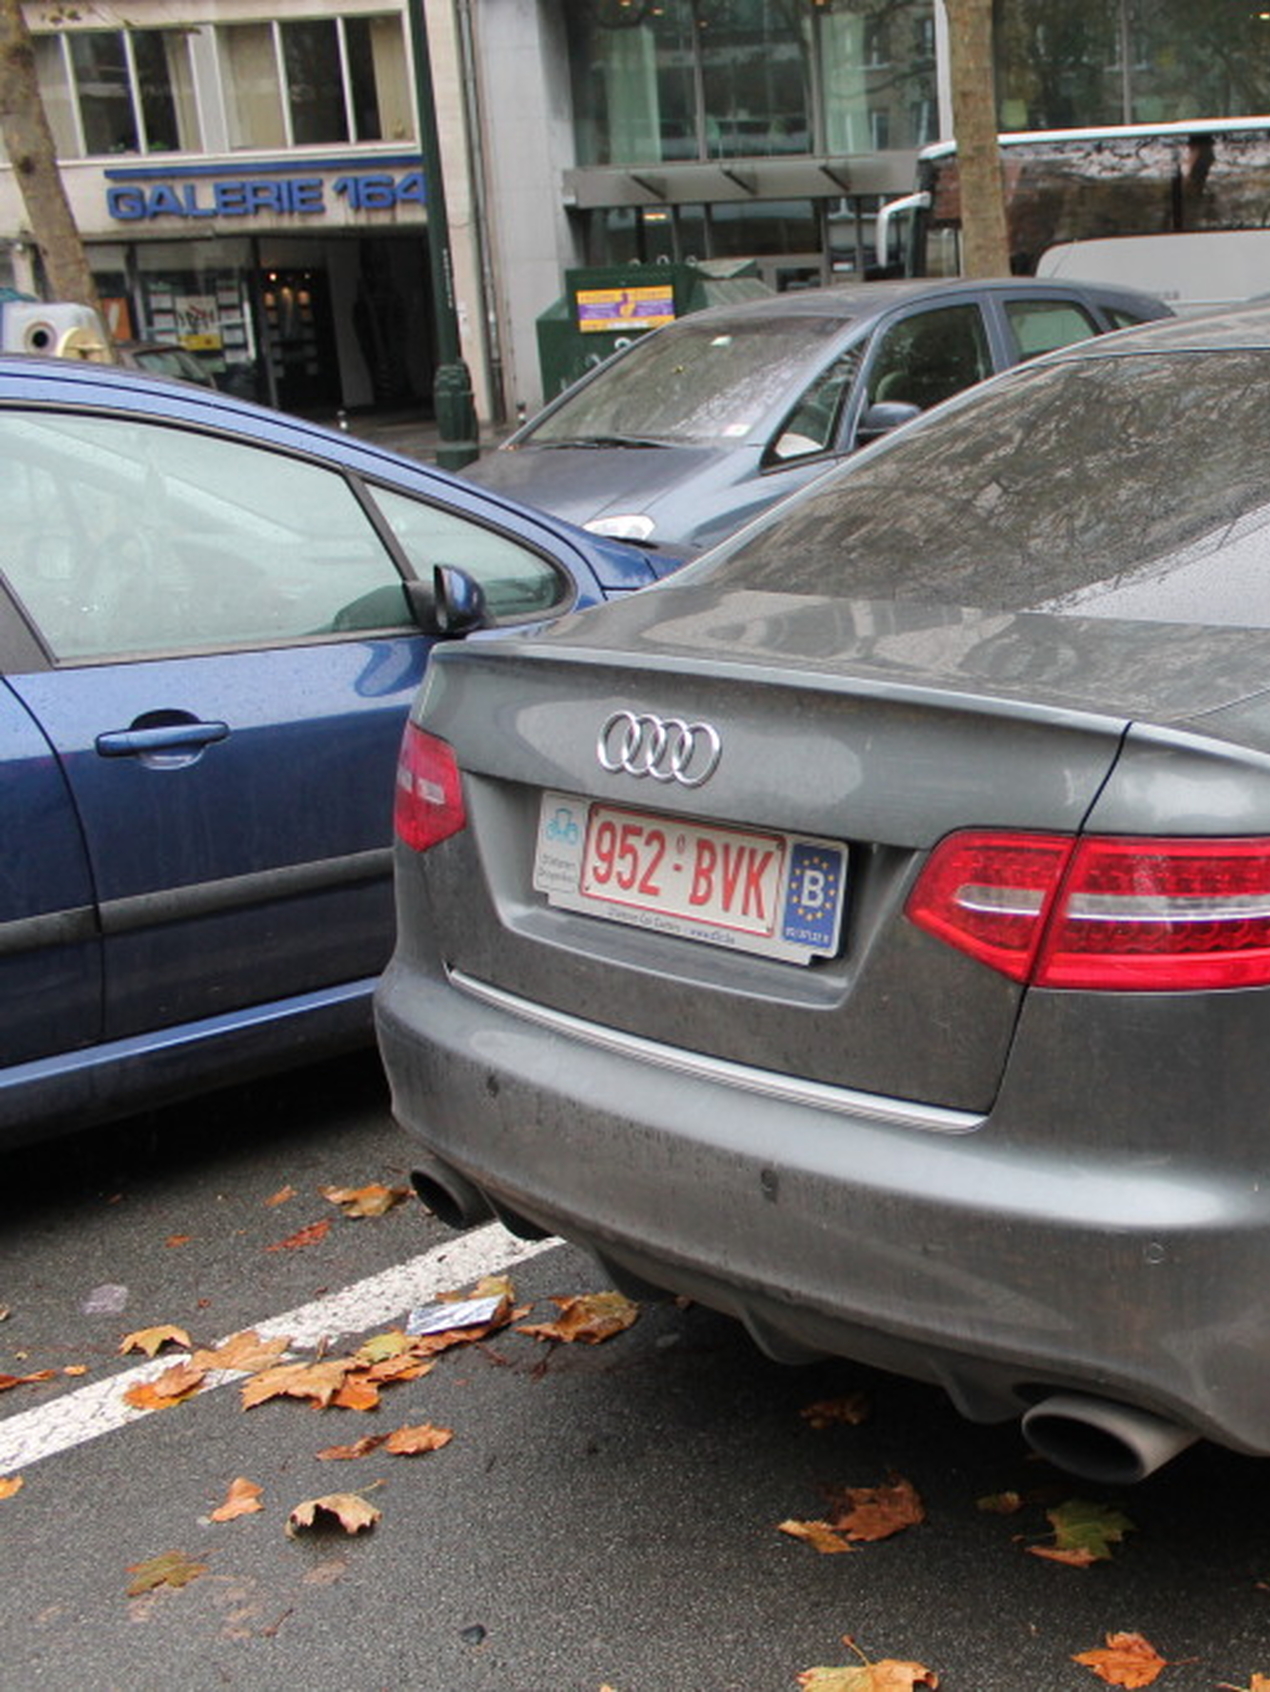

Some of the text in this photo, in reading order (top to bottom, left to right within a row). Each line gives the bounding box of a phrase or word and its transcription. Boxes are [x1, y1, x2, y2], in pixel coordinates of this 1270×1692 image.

[106, 173, 426, 220] GALERIE 164
[800, 869, 826, 908] B
